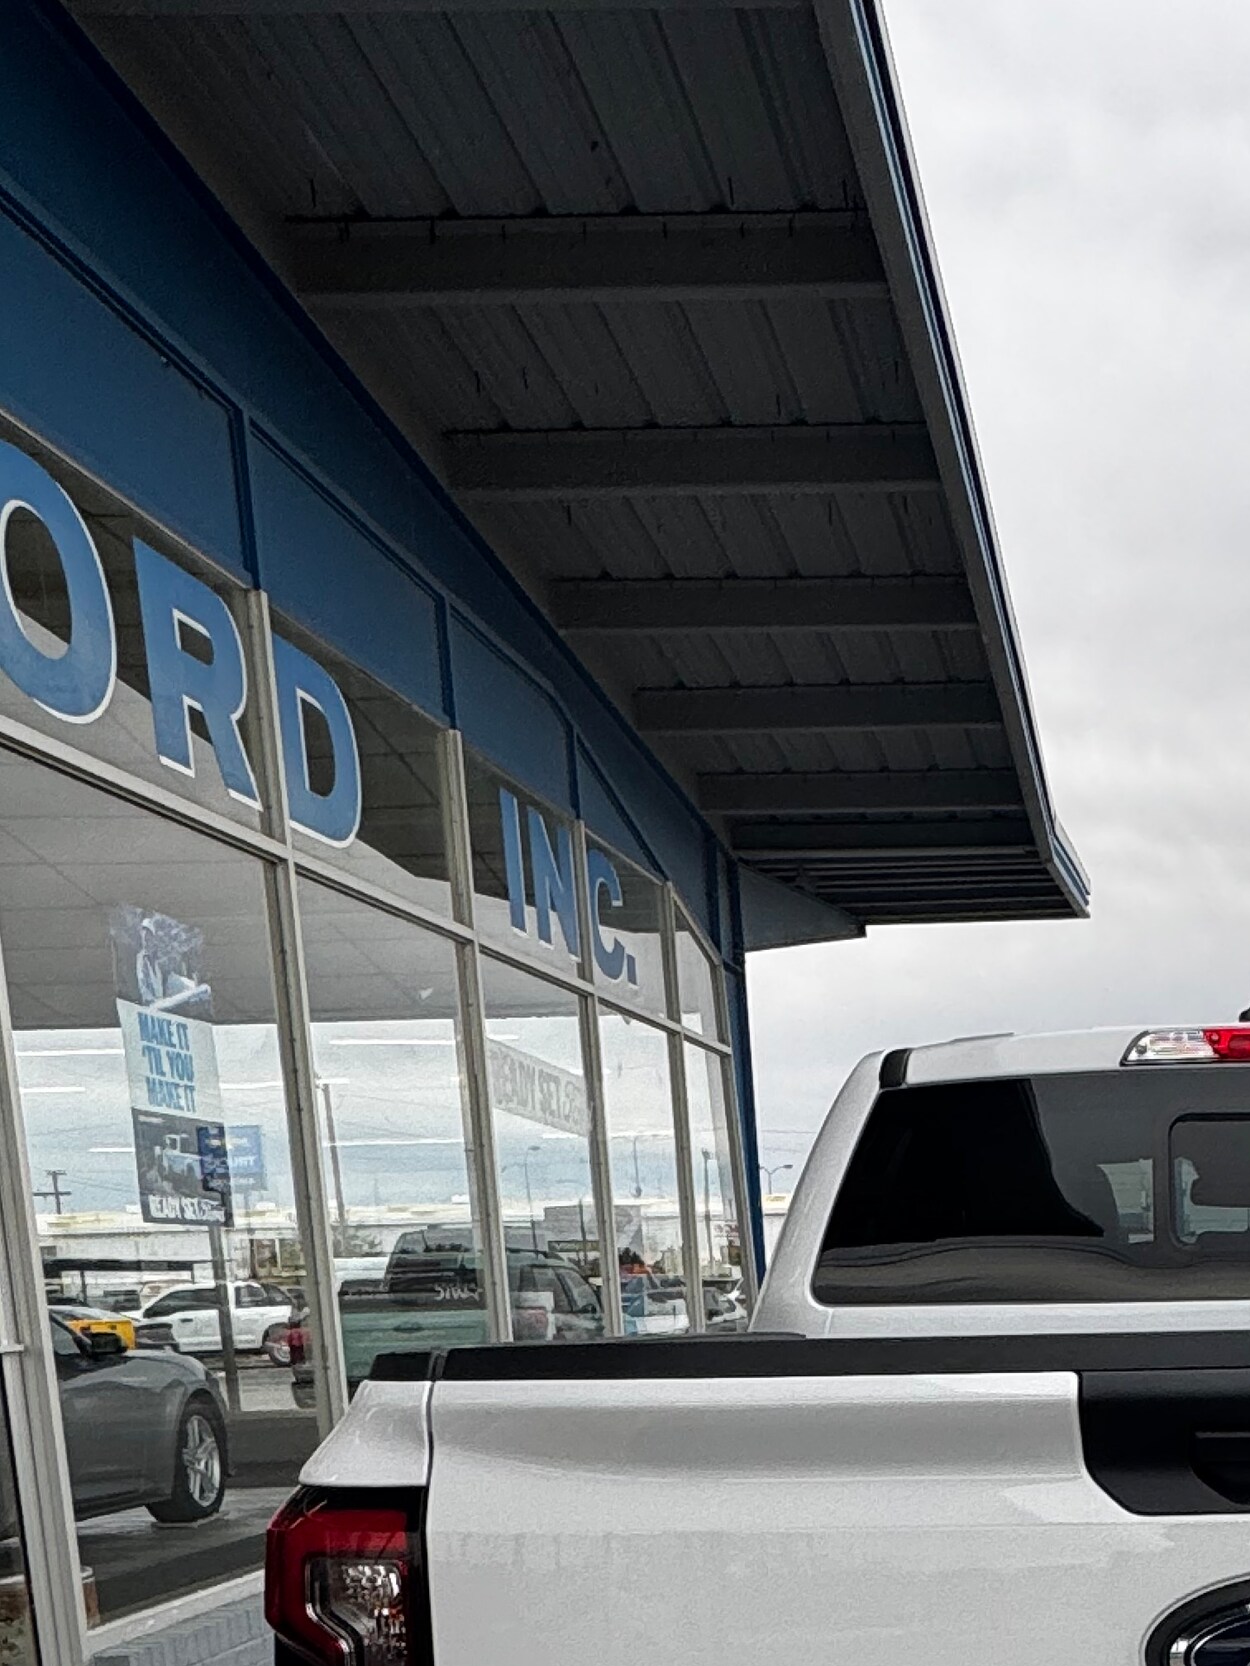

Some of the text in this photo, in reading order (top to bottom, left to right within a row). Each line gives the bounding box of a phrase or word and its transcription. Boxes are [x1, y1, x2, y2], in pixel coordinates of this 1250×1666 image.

[0, 438, 639, 989] ORD INC.
[137, 1012, 190, 1052] MAKE IT
[165, 1049, 195, 1083] YOU
[179, 1083, 197, 1114] IT
